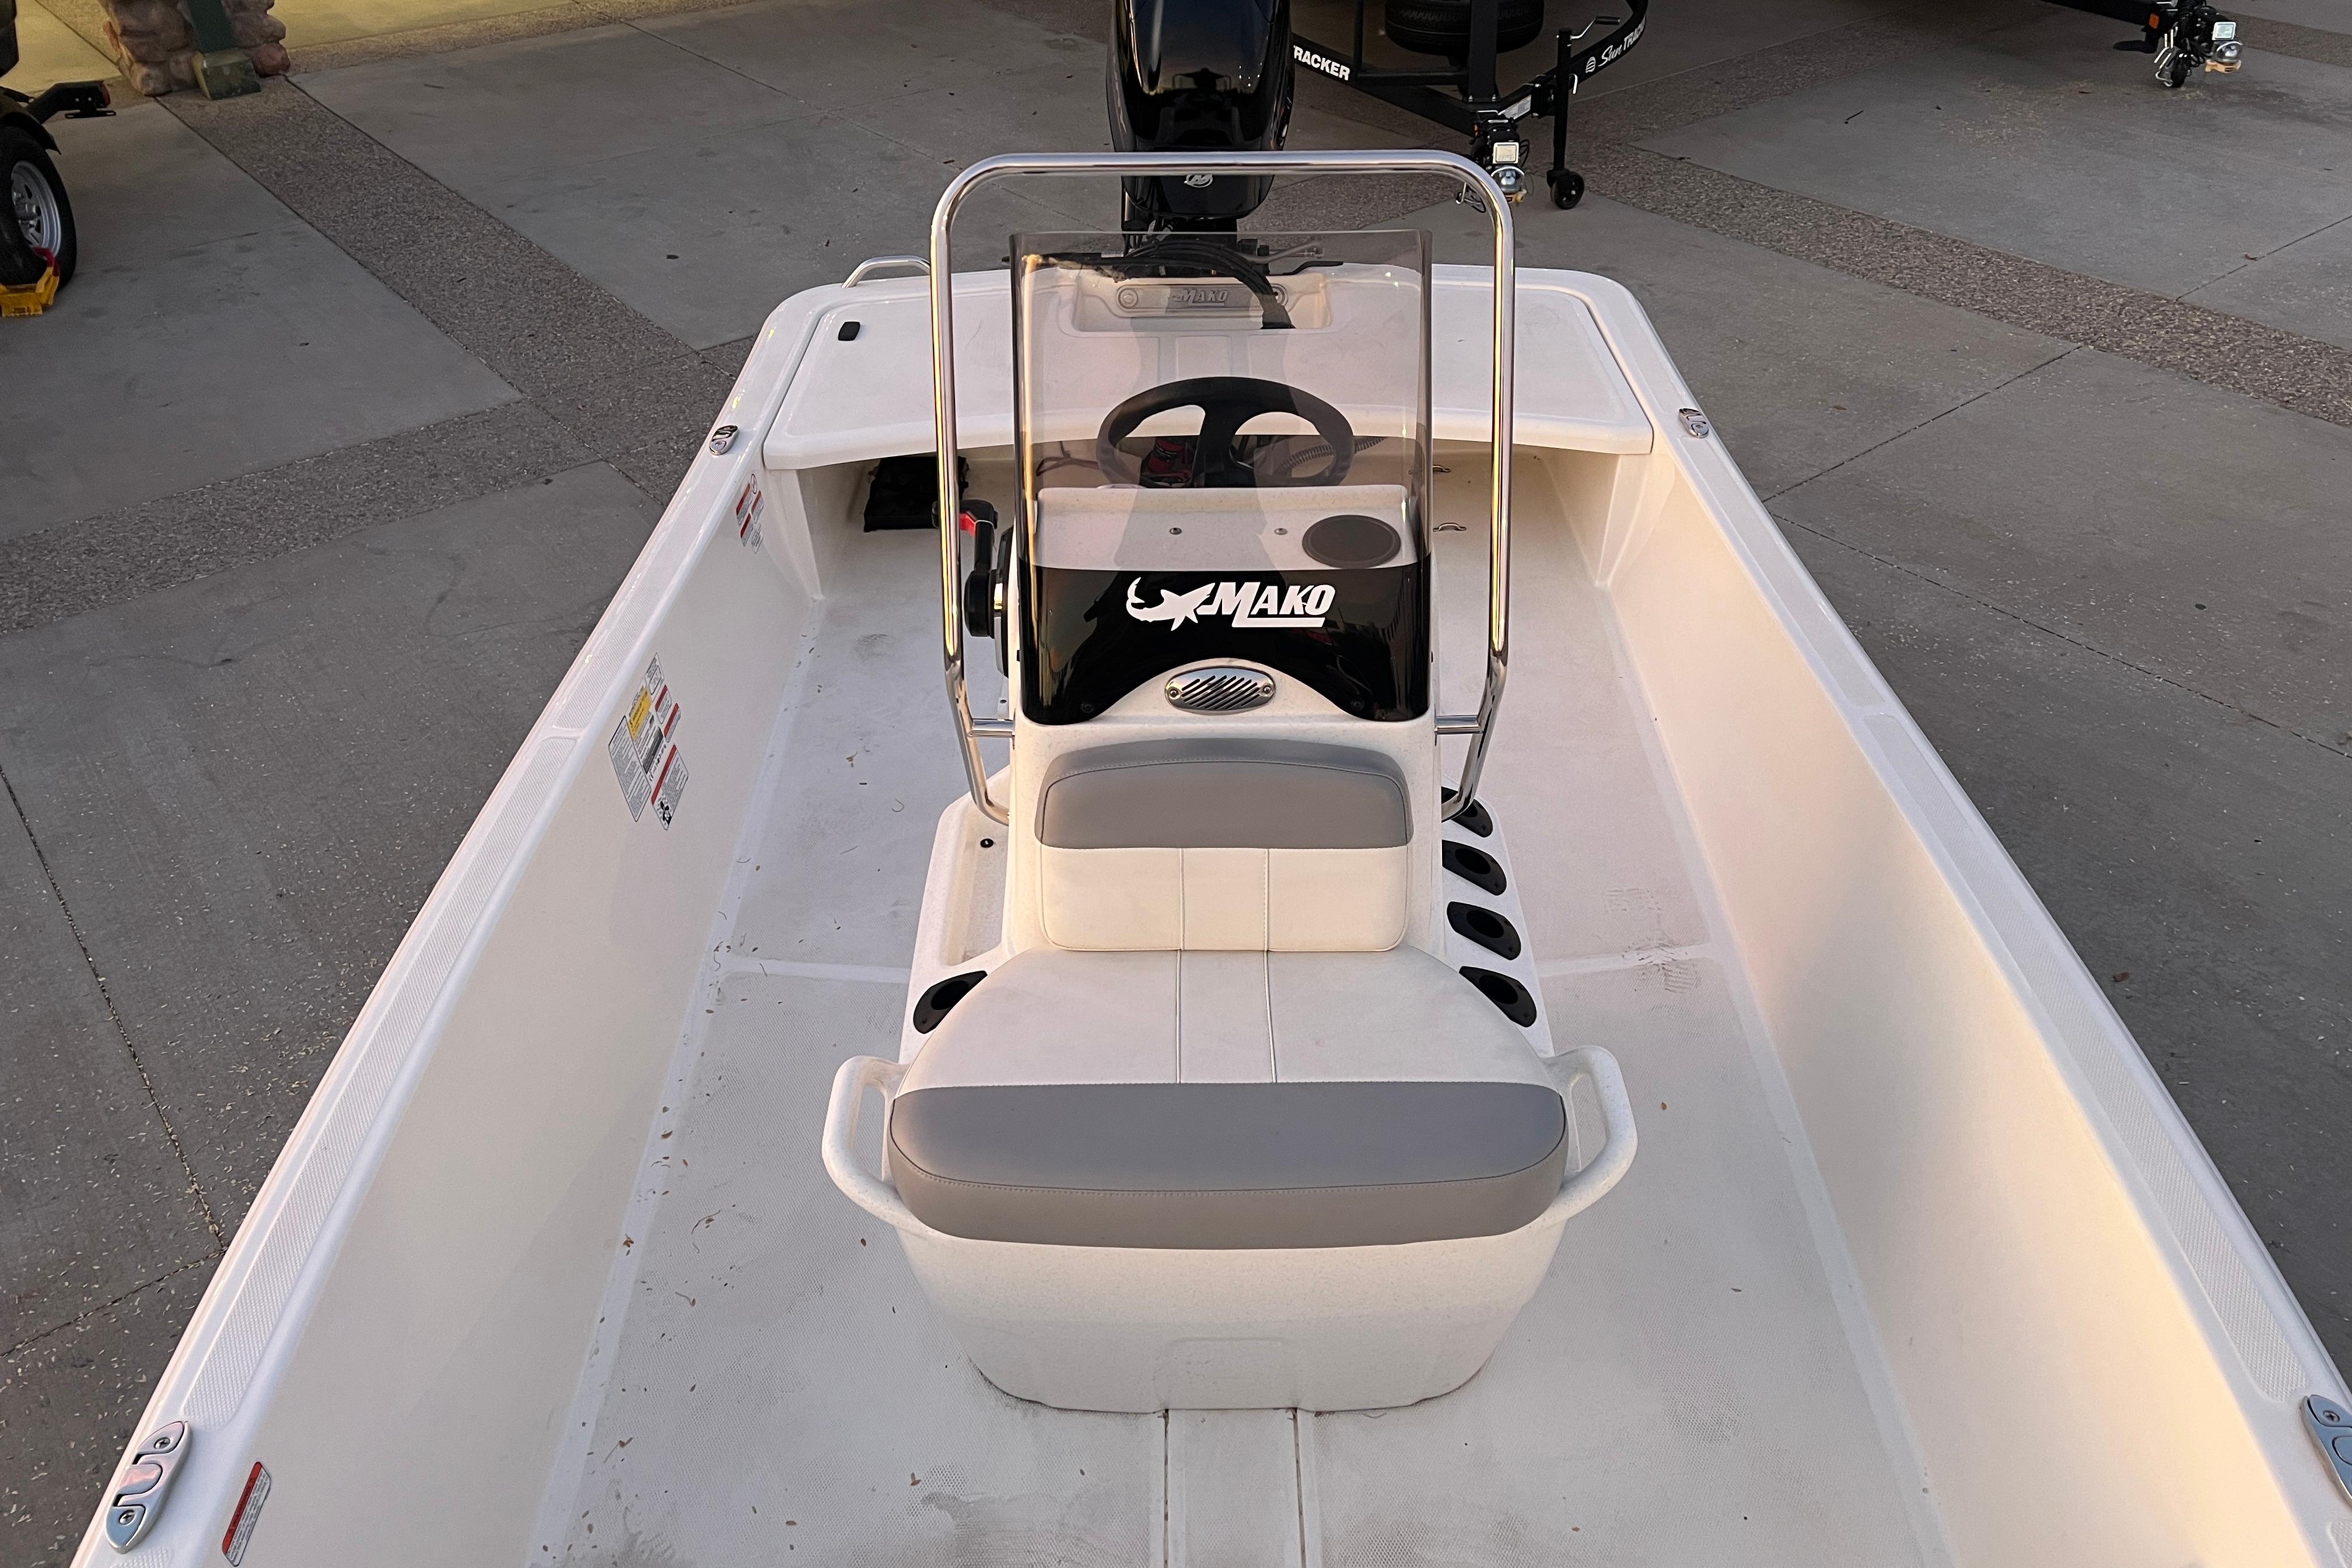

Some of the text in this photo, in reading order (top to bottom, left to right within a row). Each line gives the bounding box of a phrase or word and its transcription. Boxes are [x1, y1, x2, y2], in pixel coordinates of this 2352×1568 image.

[1293, 45, 1350, 81] RACKER
[1598, 44, 1622, 66] Sun
[1173, 288, 1228, 306] MAKO
[1197, 582, 1336, 628] MAKO
